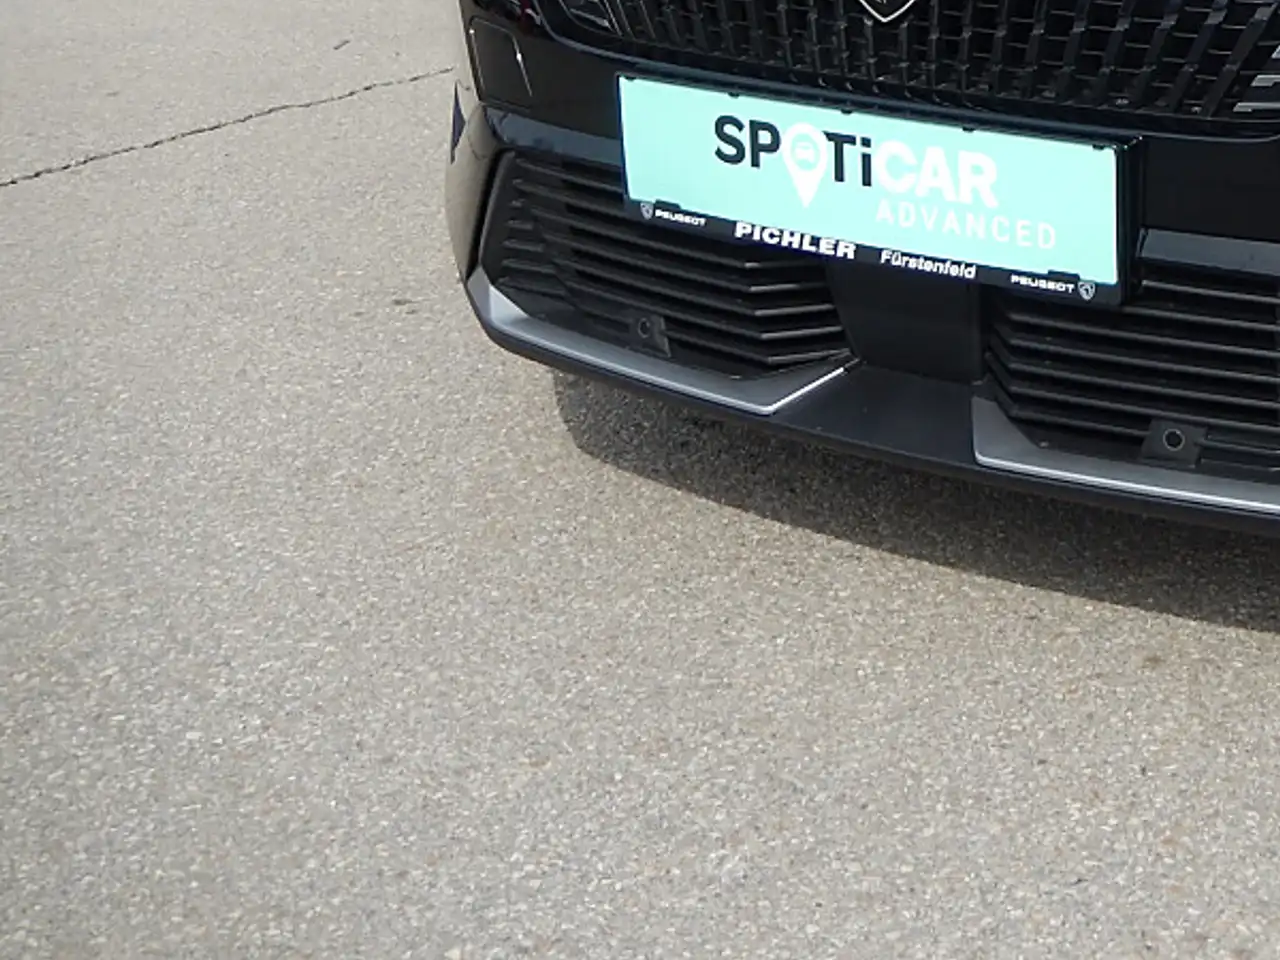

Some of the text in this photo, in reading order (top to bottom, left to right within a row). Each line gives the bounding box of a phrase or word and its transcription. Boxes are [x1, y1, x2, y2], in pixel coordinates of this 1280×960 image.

[655, 208, 1076, 295] PEUGEOT PICHLER Fürstenfeld PEUGEOT
[875, 198, 1056, 250] ADVANCED
